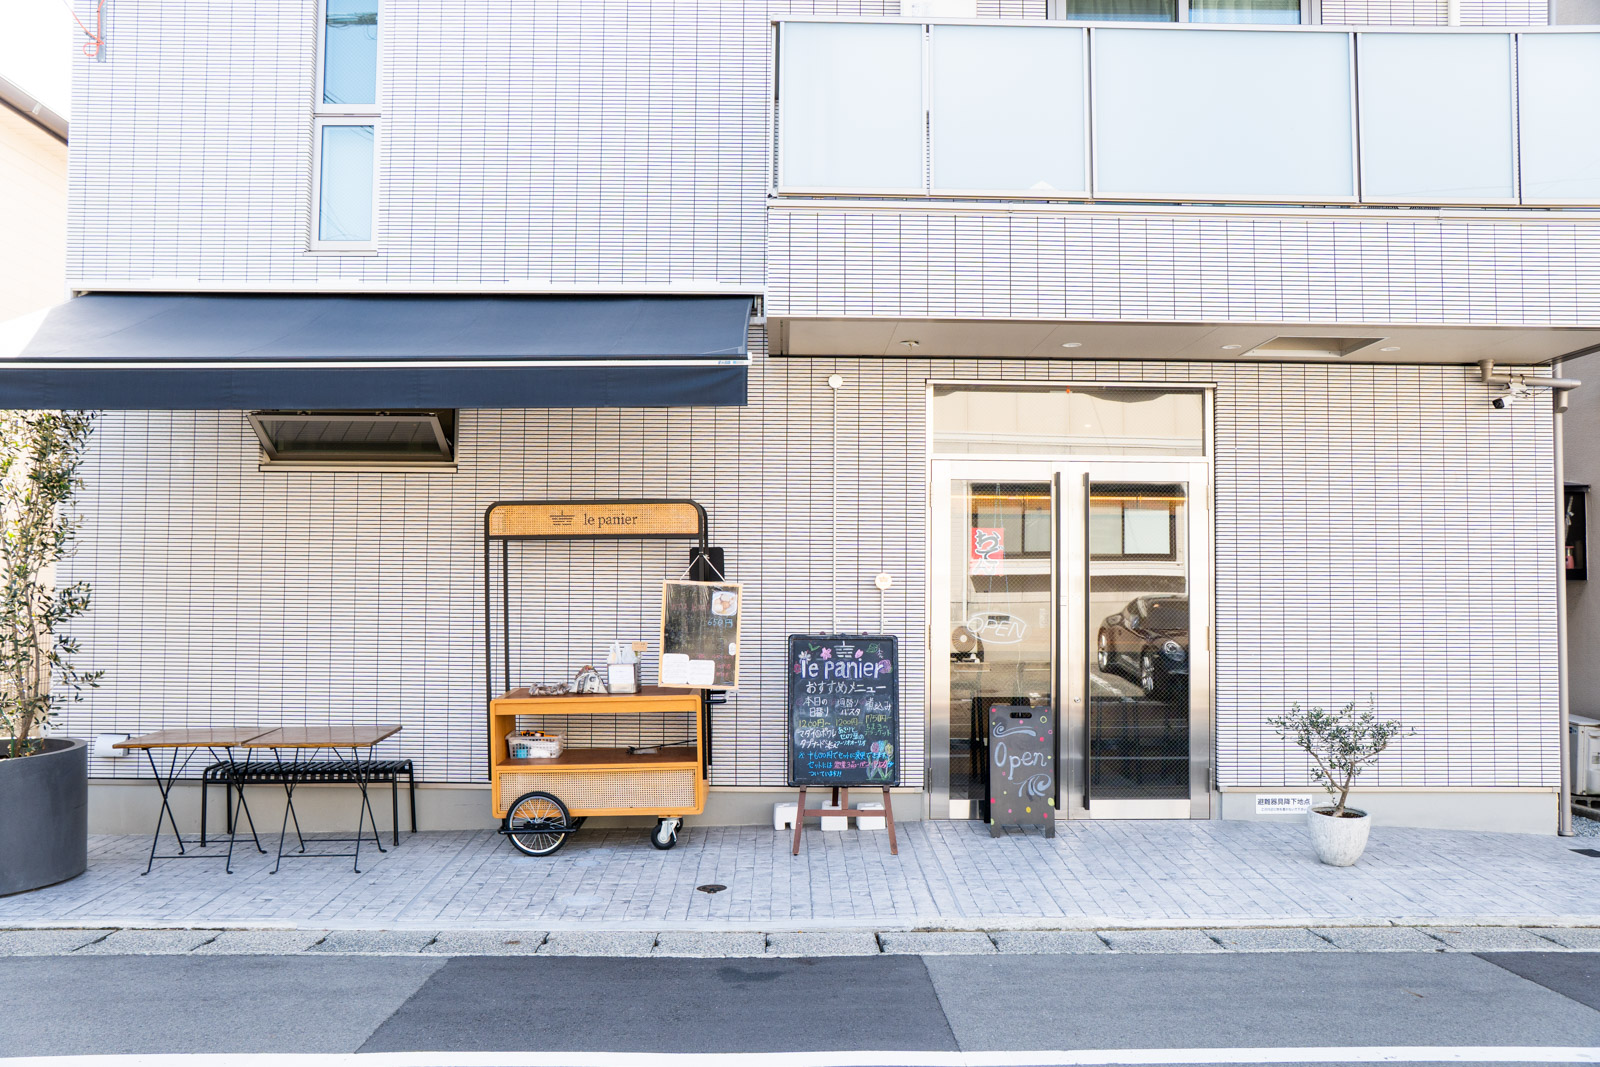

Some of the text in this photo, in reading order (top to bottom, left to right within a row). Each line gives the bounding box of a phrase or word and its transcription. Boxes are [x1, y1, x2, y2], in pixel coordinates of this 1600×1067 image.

[583, 513, 638, 529] le panier
[966, 616, 1027, 639] OPEN
[801, 659, 820, 679] le
[805, 681, 887, 694] おすすめメニュー
[803, 696, 828, 706] 本日の
[994, 741, 1047, 780] Open
